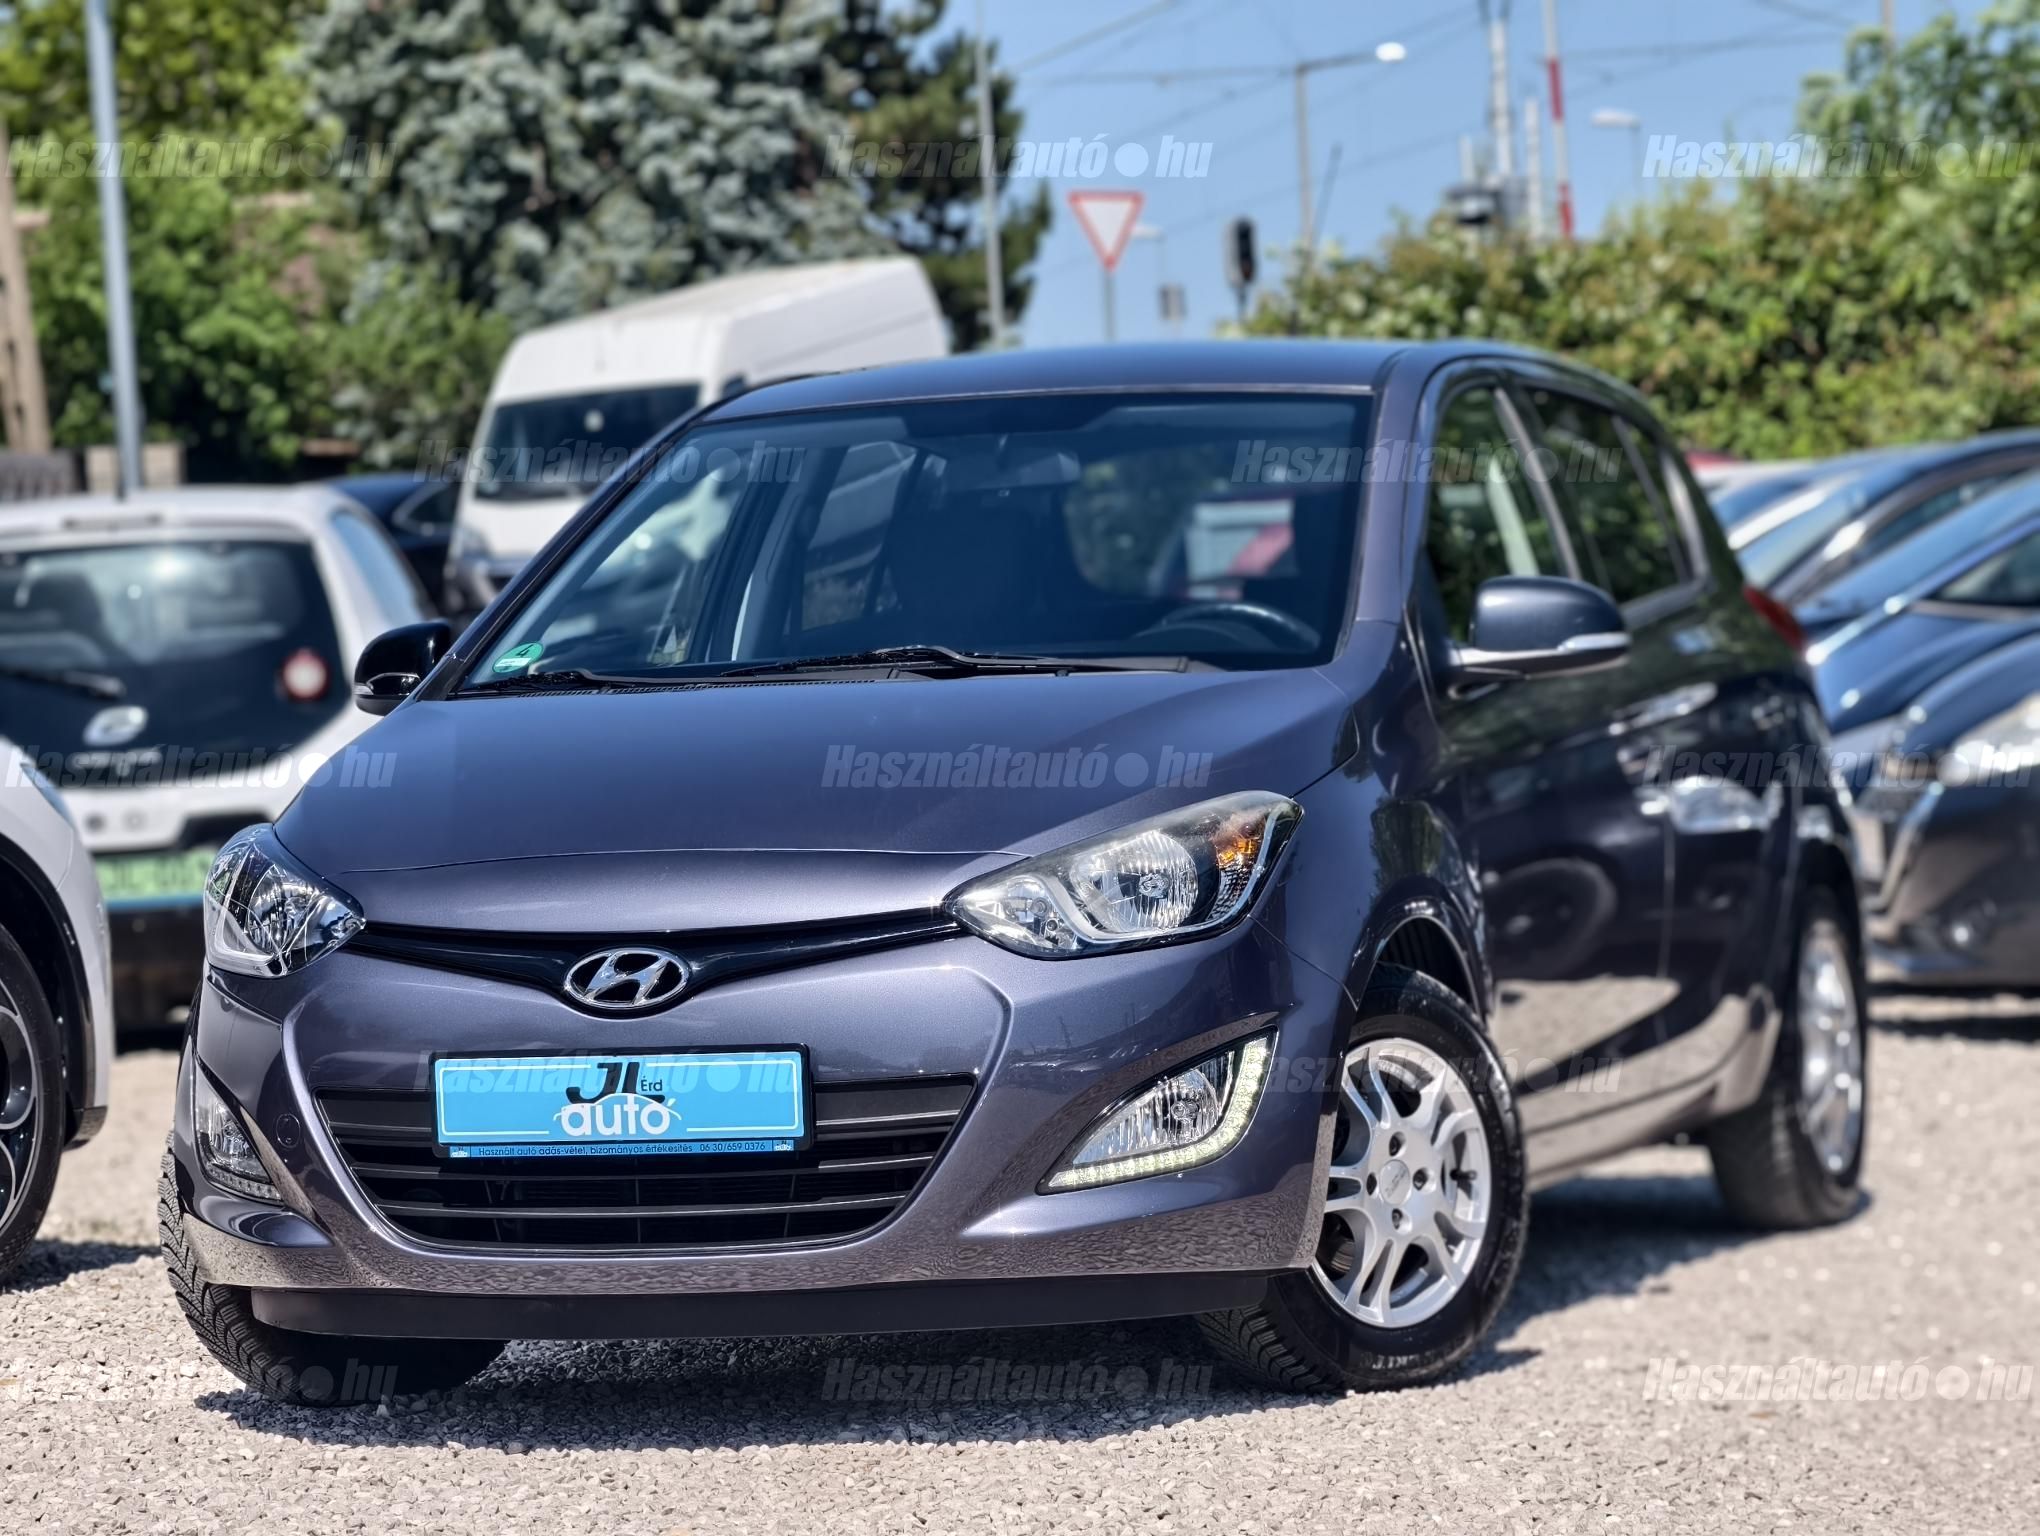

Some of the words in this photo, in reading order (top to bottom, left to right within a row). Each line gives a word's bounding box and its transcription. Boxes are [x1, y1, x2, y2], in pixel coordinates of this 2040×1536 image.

[640, 1075, 663, 1092] Érd
[560, 1093, 676, 1136] autó
[478, 1146, 515, 1157] Használt
[516, 1146, 536, 1157] autó
[590, 1144, 643, 1156] bizományos
[699, 1142, 711, 1152] 06
[712, 1142, 742, 1152] 30/659
[744, 1142, 766, 1151] 0376
